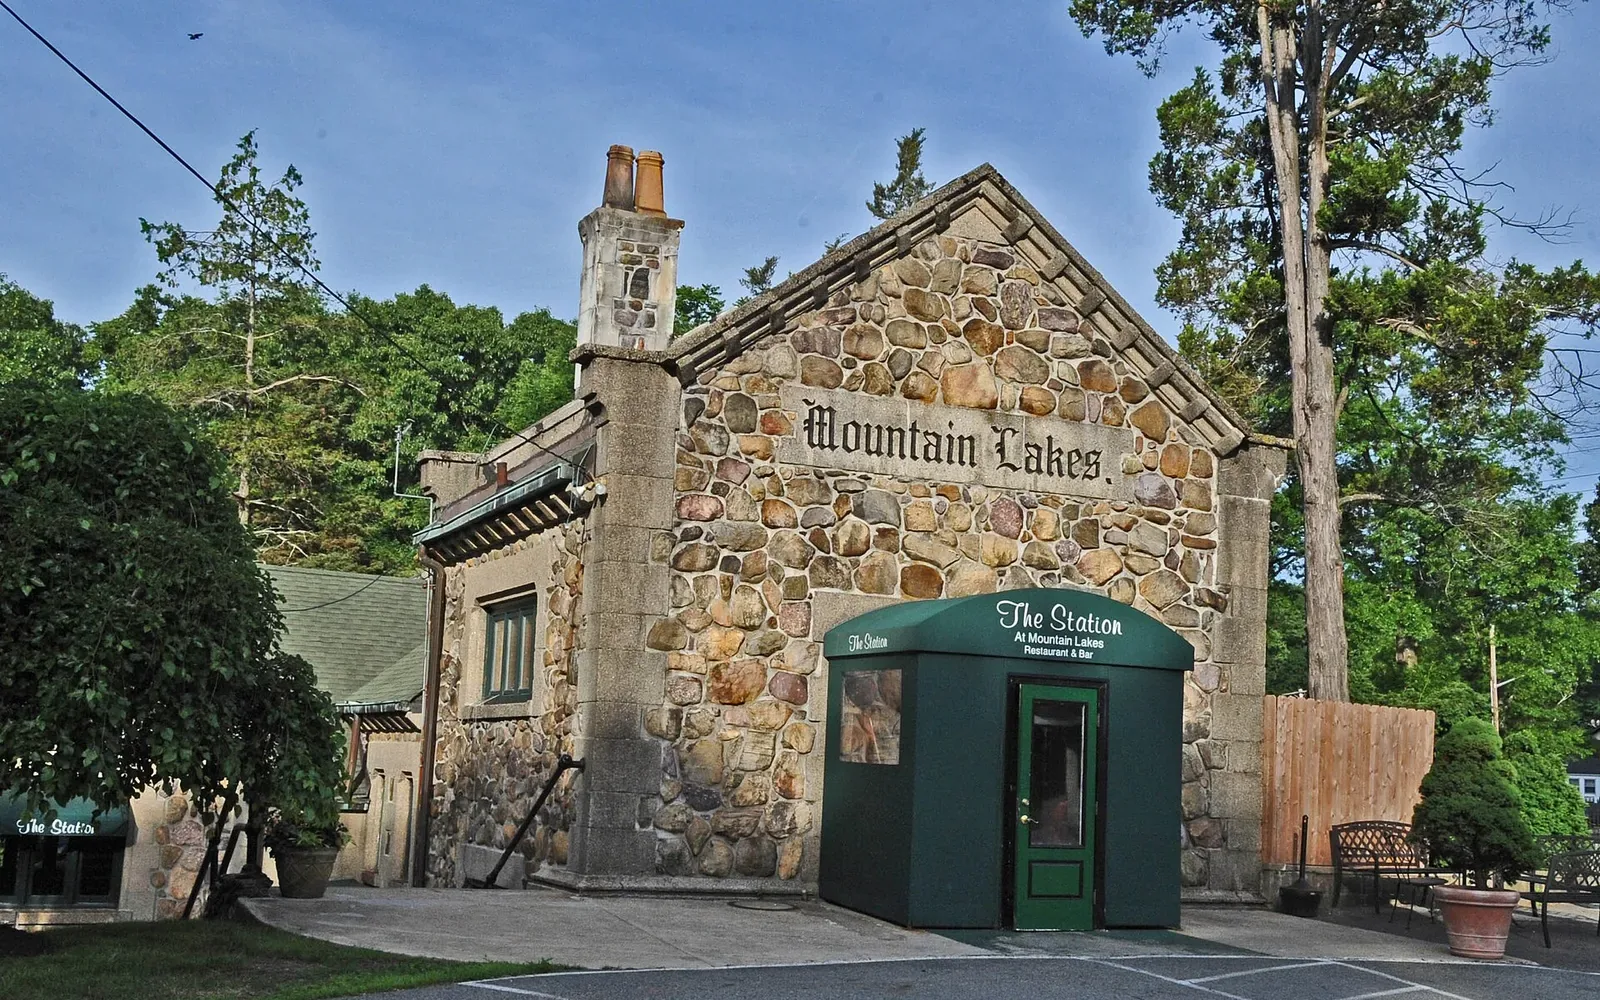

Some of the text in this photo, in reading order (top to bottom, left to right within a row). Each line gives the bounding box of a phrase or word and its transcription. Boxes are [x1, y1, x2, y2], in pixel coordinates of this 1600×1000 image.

[802, 398, 1113, 485] Mountain Lakes.
[996, 600, 1123, 636] The Station
[848, 632, 888, 652] The Station
[1014, 631, 1104, 649] At Mountain Lakes
[1024, 645, 1093, 659] Restaurant & Bar
[16, 818, 45, 834] The
